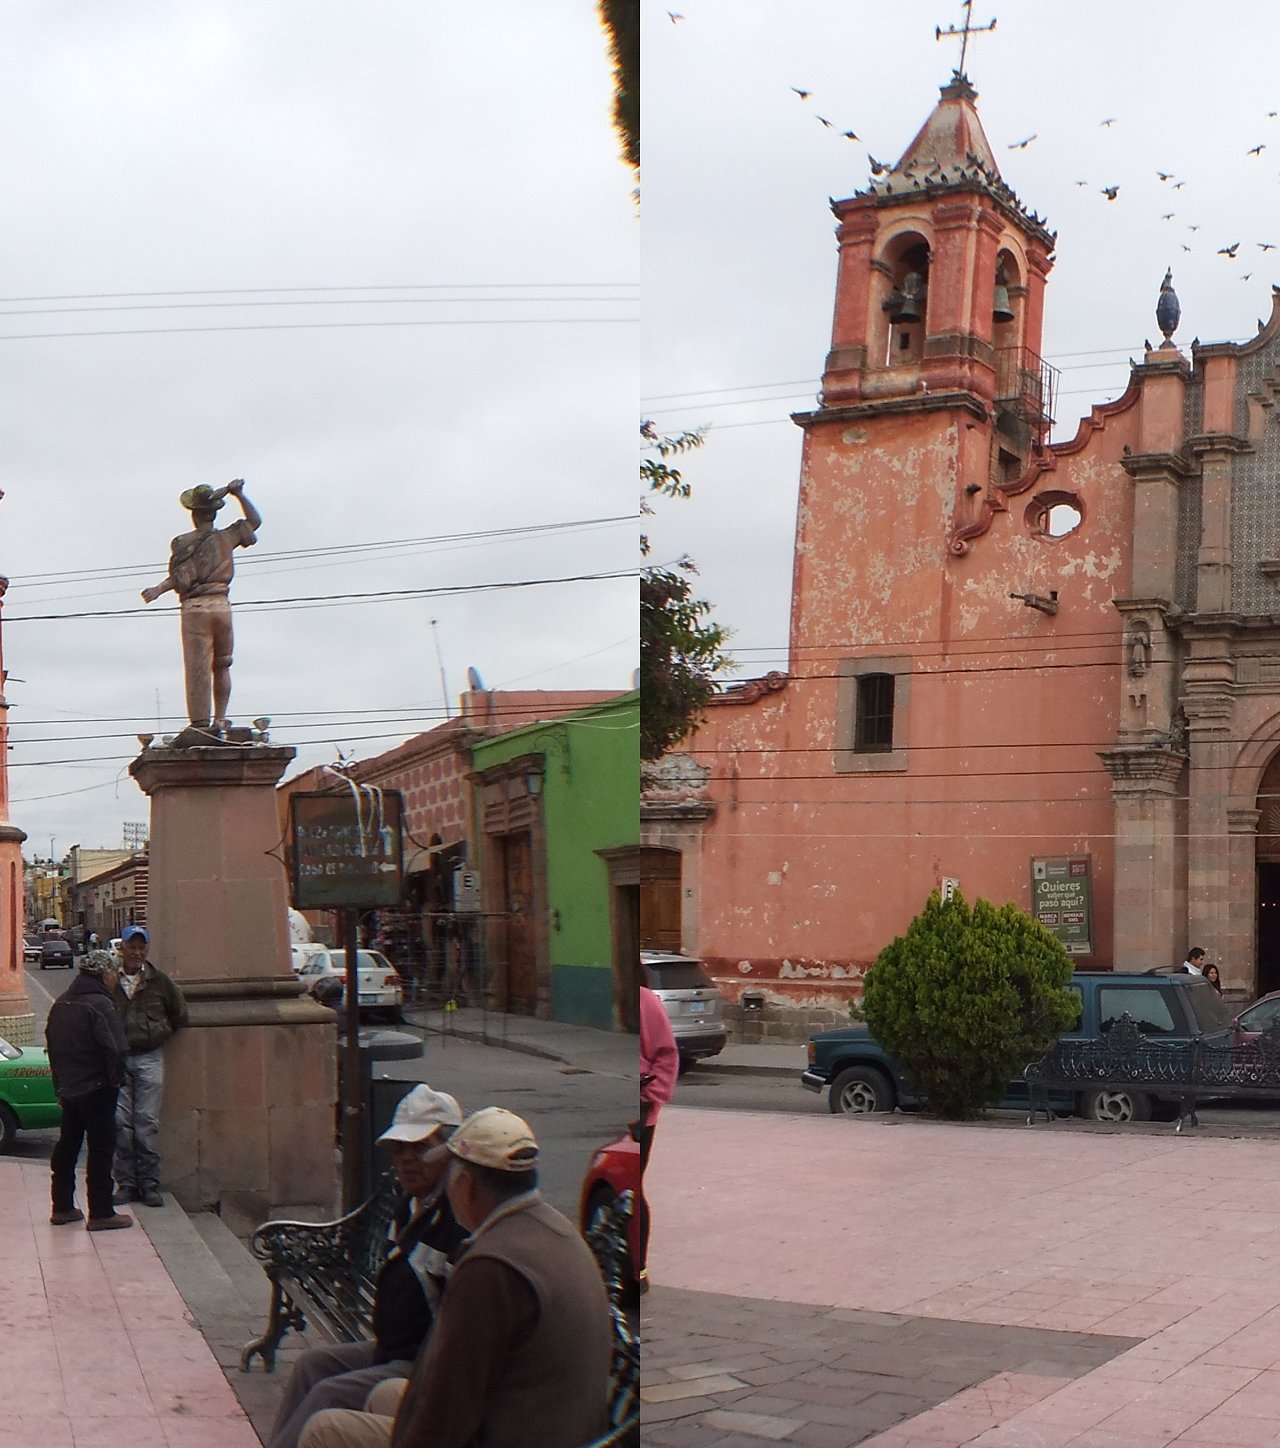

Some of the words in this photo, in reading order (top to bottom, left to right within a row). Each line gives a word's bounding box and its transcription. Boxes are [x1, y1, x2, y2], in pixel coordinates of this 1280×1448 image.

[464, 875, 472, 888] E
[1037, 881, 1080, 894] ¿Quieres
[1047, 892, 1063, 900] saber
[1039, 897, 1059, 910] pasó
[1061, 896, 1084, 909] aquí?
